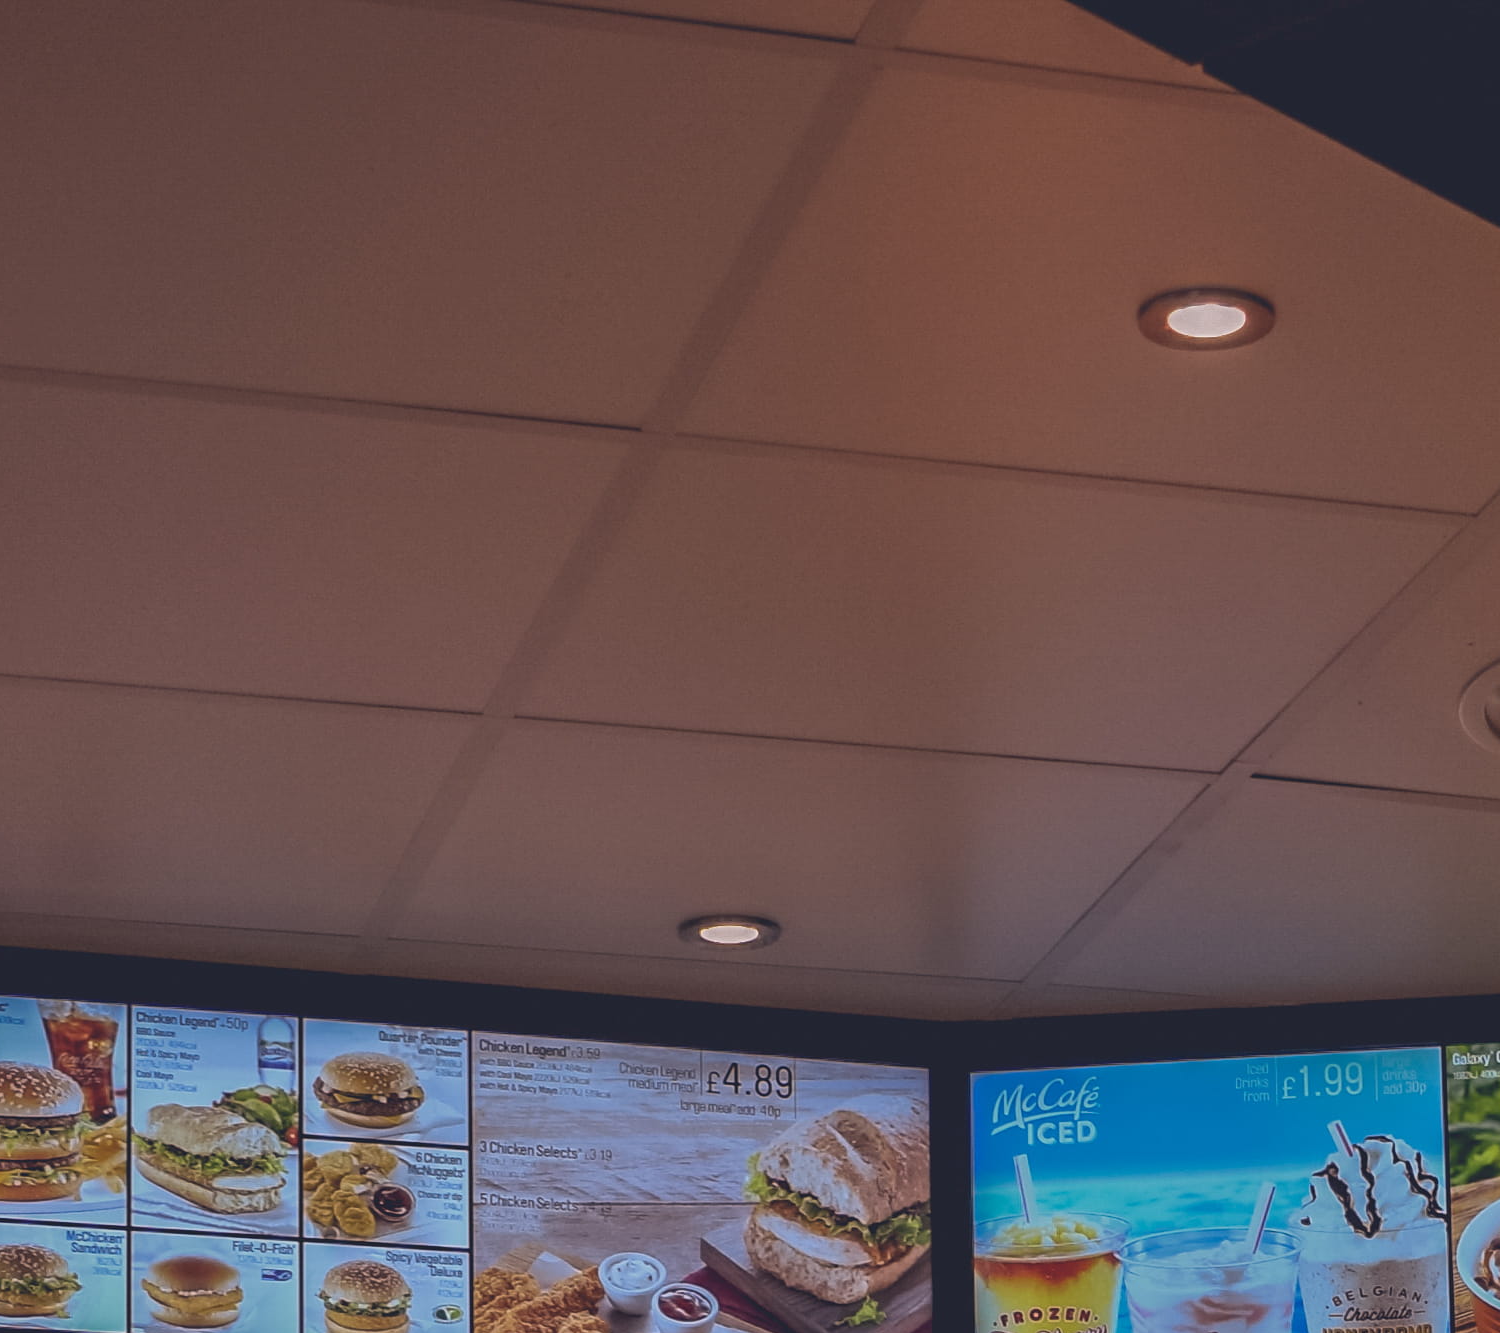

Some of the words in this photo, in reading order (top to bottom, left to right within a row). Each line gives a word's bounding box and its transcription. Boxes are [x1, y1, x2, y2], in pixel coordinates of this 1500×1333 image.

[136, 1012, 177, 1026] Chicken
[180, 1014, 217, 1030] Legend
[379, 1031, 418, 1044] Quarter
[421, 1034, 462, 1047] Pounder
[480, 1039, 525, 1055] Chicken
[526, 1043, 567, 1060] Legend
[1452, 1052, 1492, 1067] Galaxy
[619, 1061, 659, 1077] Chicken
[661, 1064, 696, 1081] Legend
[1247, 1063, 1269, 1076] Iced
[1382, 1069, 1417, 1082] drinks
[628, 1078, 670, 1091] medium
[706, 1061, 794, 1100] £4.89
[1235, 1076, 1269, 1090] Drinks
[1281, 1061, 1364, 1100] £1.99
[1383, 1083, 1403, 1095] add
[1405, 1080, 1427, 1096] 30p
[991, 1076, 1101, 1130] McCafé
[1243, 1090, 1270, 1103] from
[680, 1099, 706, 1114] large
[737, 1105, 756, 1116] add
[1027, 1120, 1097, 1146] ICED
[479, 1141, 487, 1153] 3
[489, 1141, 535, 1157] Chicken
[536, 1144, 579, 1160] Selects
[416, 1152, 422, 1163] 6
[424, 1152, 462, 1166] Chicken
[408, 1165, 464, 1181] McNuggets
[480, 1193, 487, 1206] 5
[489, 1193, 535, 1209] Chicken
[536, 1196, 579, 1212] Selects
[66, 1230, 122, 1244] McChicken
[71, 1242, 122, 1255] Sandwich
[233, 1241, 293, 1255] Filet-O-Fish
[386, 1250, 412, 1265] Spicy
[414, 1252, 463, 1266] Vegetable
[430, 1266, 463, 1279] Deluxe
[1331, 1285, 1422, 1308] BELGIAN
[1000, 1306, 1092, 1328] FROZEN
[1343, 1304, 1413, 1322] Chocolate
